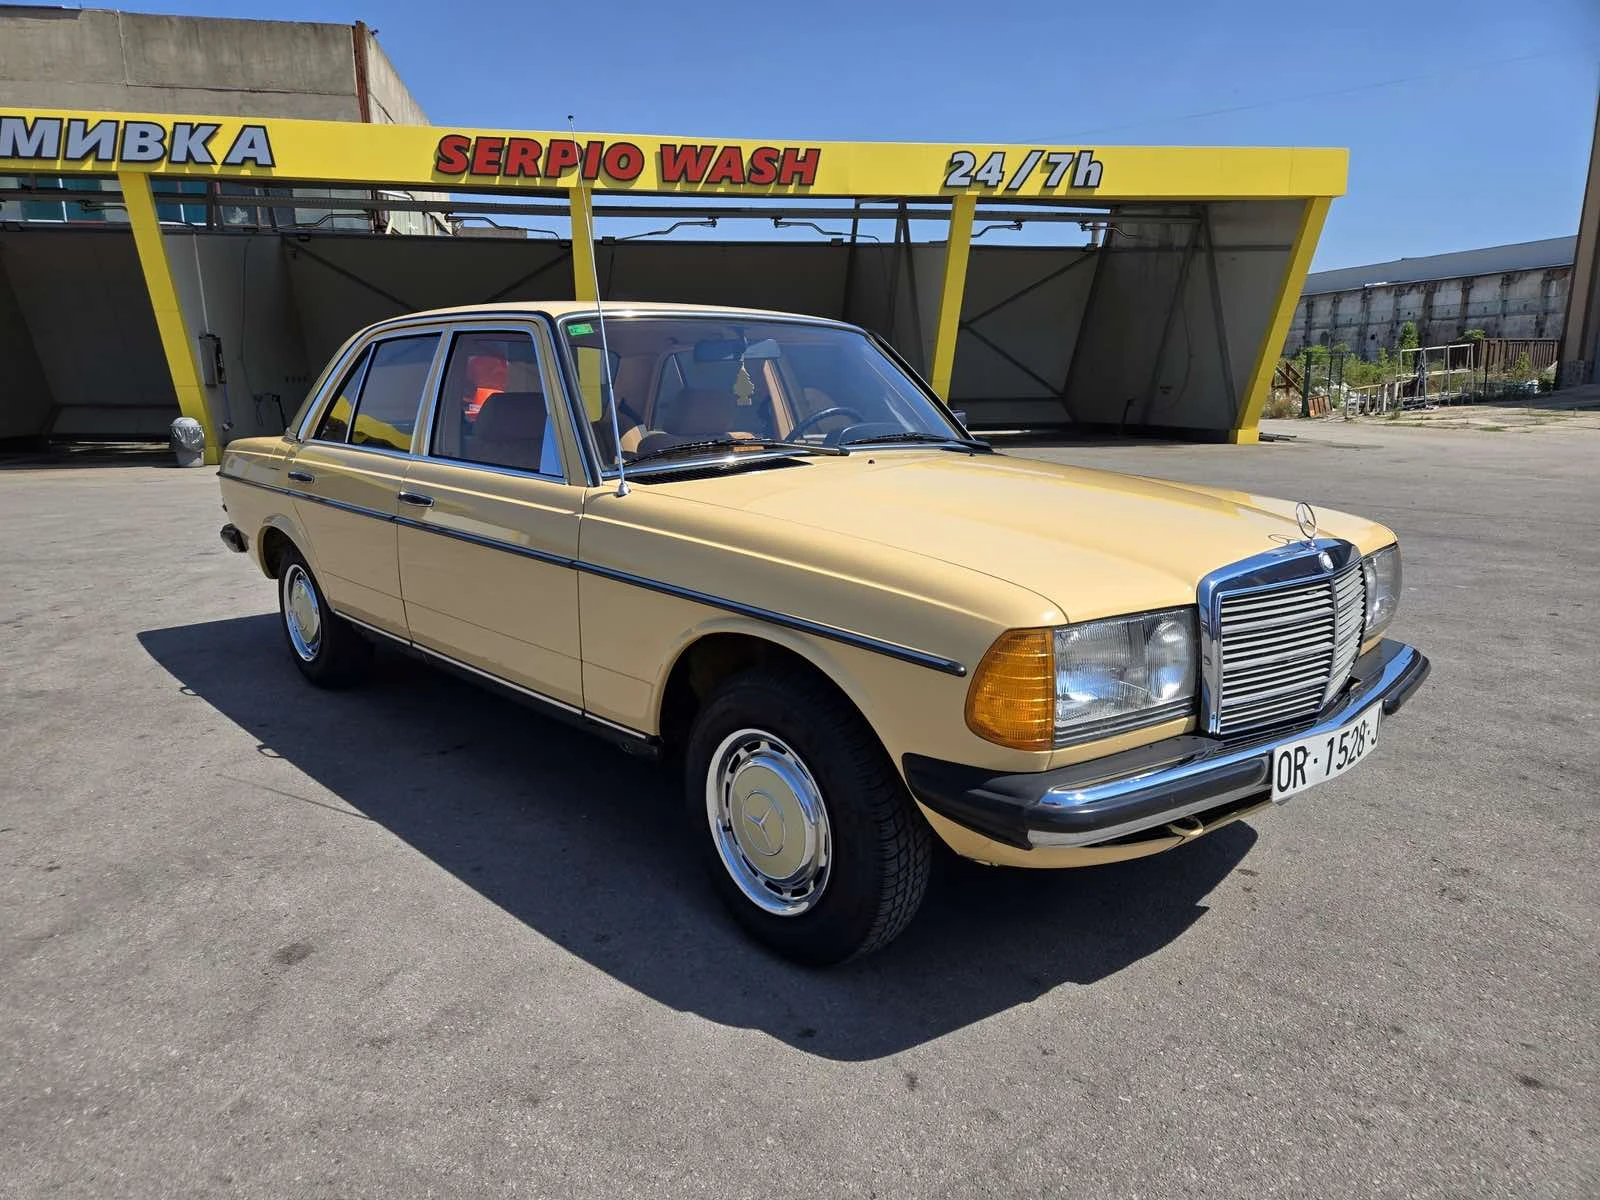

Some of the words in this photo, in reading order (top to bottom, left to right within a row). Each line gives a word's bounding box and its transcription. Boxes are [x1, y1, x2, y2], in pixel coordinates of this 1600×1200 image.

[435, 134, 645, 182] SERPIO
[660, 143, 821, 185] WASH
[946, 149, 1103, 190] 24/7h
